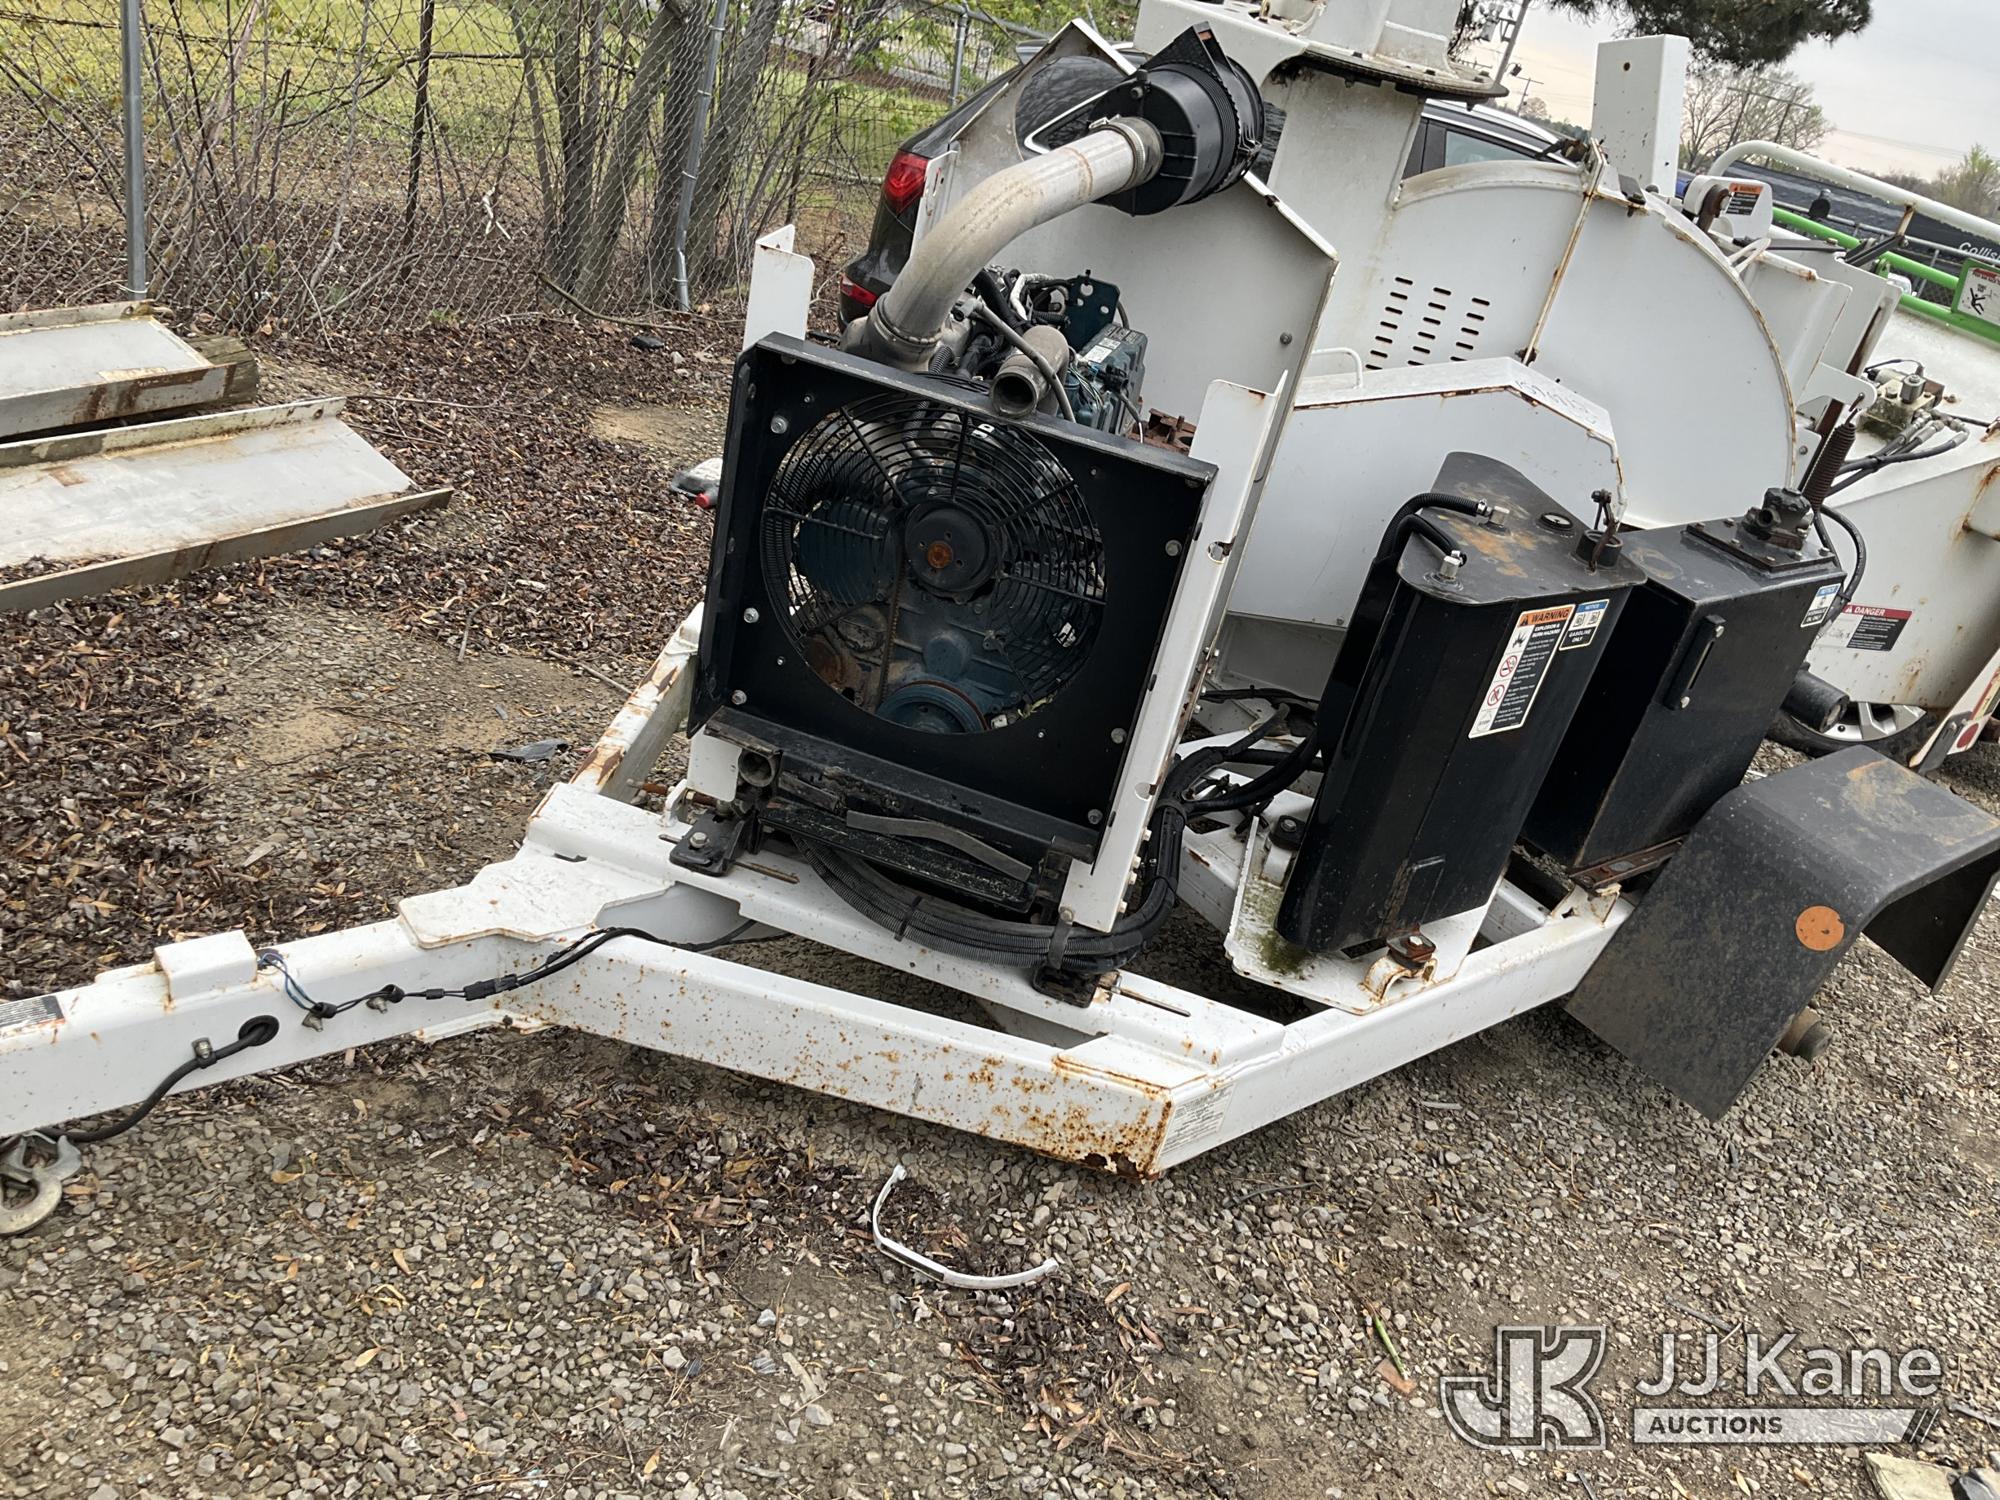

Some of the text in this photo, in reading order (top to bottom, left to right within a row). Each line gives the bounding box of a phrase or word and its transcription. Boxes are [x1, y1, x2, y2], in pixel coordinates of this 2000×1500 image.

[1959, 242, 2000, 260] Collis
[1532, 609, 1570, 622] WARNING
[1854, 608, 1886, 616] DANGER
[1568, 629, 1592, 638] GASOLINE
